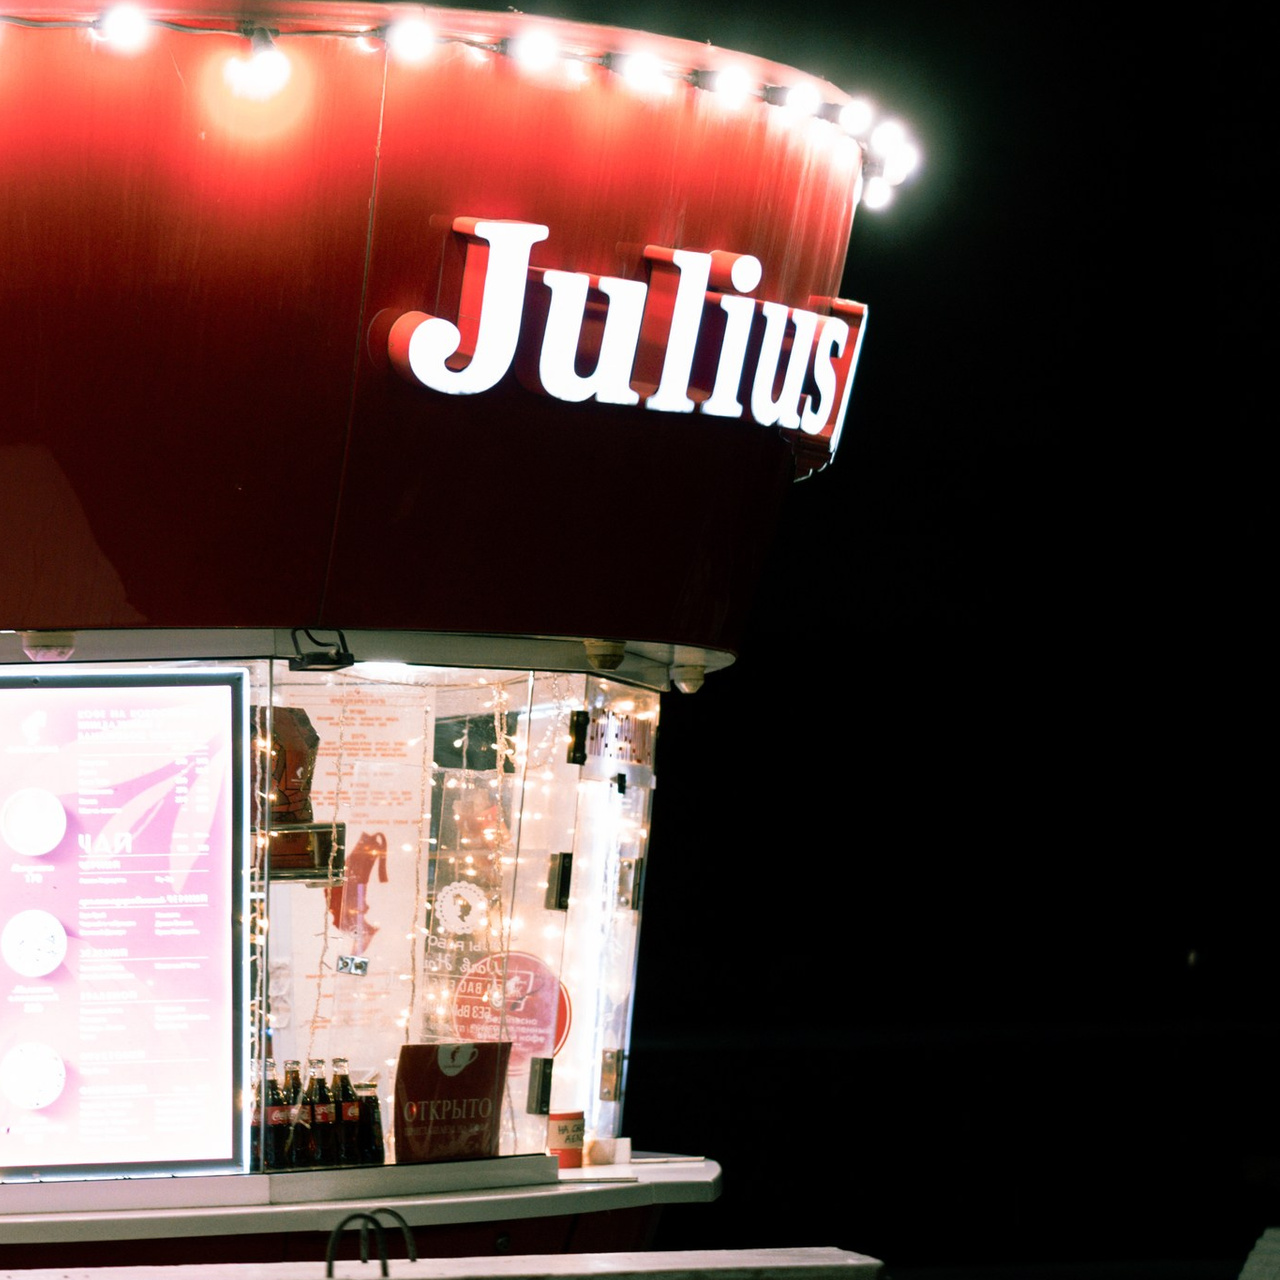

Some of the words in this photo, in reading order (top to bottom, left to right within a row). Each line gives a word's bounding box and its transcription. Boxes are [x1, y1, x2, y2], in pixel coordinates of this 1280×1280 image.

[407, 220, 849, 436] Julius
[78, 832, 133, 855] ЧАЙ
[404, 1097, 492, 1122] ОТКРЫТО
